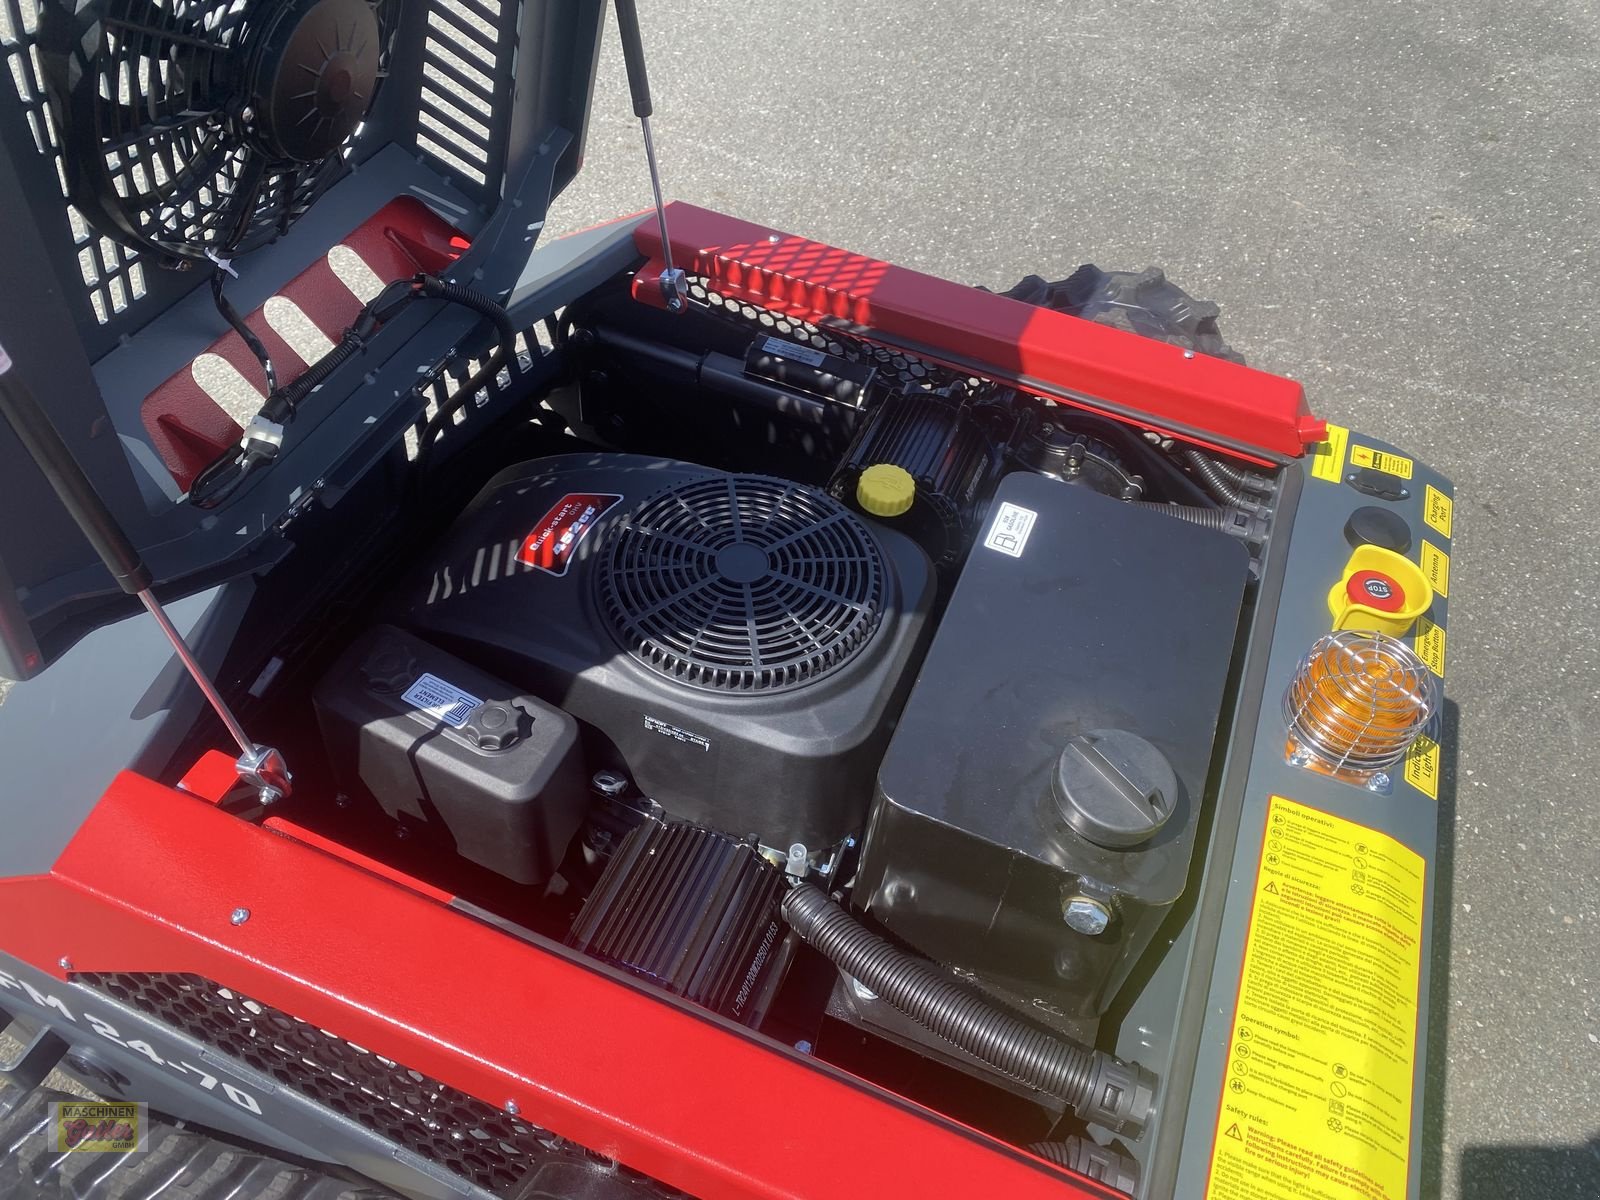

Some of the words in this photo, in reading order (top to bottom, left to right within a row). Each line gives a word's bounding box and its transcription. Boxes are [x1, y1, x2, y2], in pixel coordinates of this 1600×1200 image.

[569, 502, 582, 516] OHV
[1006, 511, 1019, 531] GASOLINE
[1430, 493, 1441, 523] Charging
[530, 503, 572, 551] Quick-start
[552, 505, 596, 555] 452cc
[1431, 554, 1440, 583] Antenna
[1368, 582, 1388, 593] STOP
[1431, 652, 1439, 670] Stop
[414, 694, 432, 706] FILTER
[419, 690, 444, 704] ELEMENT
[431, 701, 442, 710] AIR
[1412, 737, 1421, 780] Indicator
[1423, 753, 1433, 778] Light
[1274, 803, 1300, 817] Simboli
[1301, 813, 1334, 829] operativi:
[1263, 865, 1282, 877] Regole
[1290, 876, 1320, 891] sicurezza:
[1240, 1013, 1272, 1030] Operation
[1274, 1026, 1299, 1040] symbol:
[84, 1013, 262, 1116] 24-70
[1226, 1104, 1248, 1120] Safety
[1248, 1114, 1268, 1126] rules:
[1244, 1147, 1255, 1156] fire
[1265, 1156, 1287, 1169] serious
[1289, 1165, 1310, 1179] injury!
[1246, 1133, 1283, 1153] instructions
[1284, 1149, 1314, 1166] carefully.
[1316, 1161, 1338, 1175] Failure
[1339, 1170, 1346, 1178] to
[1347, 1174, 1369, 1192] comply
[1246, 1140, 1275, 1159] following
[1276, 1152, 1314, 1173] instructions
[1315, 1169, 1328, 1181] may
[1330, 1175, 1348, 1187] cause
[1248, 1126, 1275, 1142] Warning:
[1276, 1137, 1296, 1151] Please
[1298, 1147, 1312, 1157] read
[1323, 1157, 1342, 1171] safety
[1343, 1166, 1373, 1184] guidelines
[1217, 1155, 1225, 1163] the
[1245, 1168, 1260, 1178] range
[1277, 1181, 1291, 1193] using
[1224, 1151, 1241, 1163] Please
[1242, 1159, 1257, 1169] make
[1258, 1166, 1269, 1175] sure
[1270, 1170, 1282, 1180] that
[1282, 1175, 1291, 1184] the
[1292, 1179, 1305, 1189] light
[1229, 1175, 1238, 1183] not
